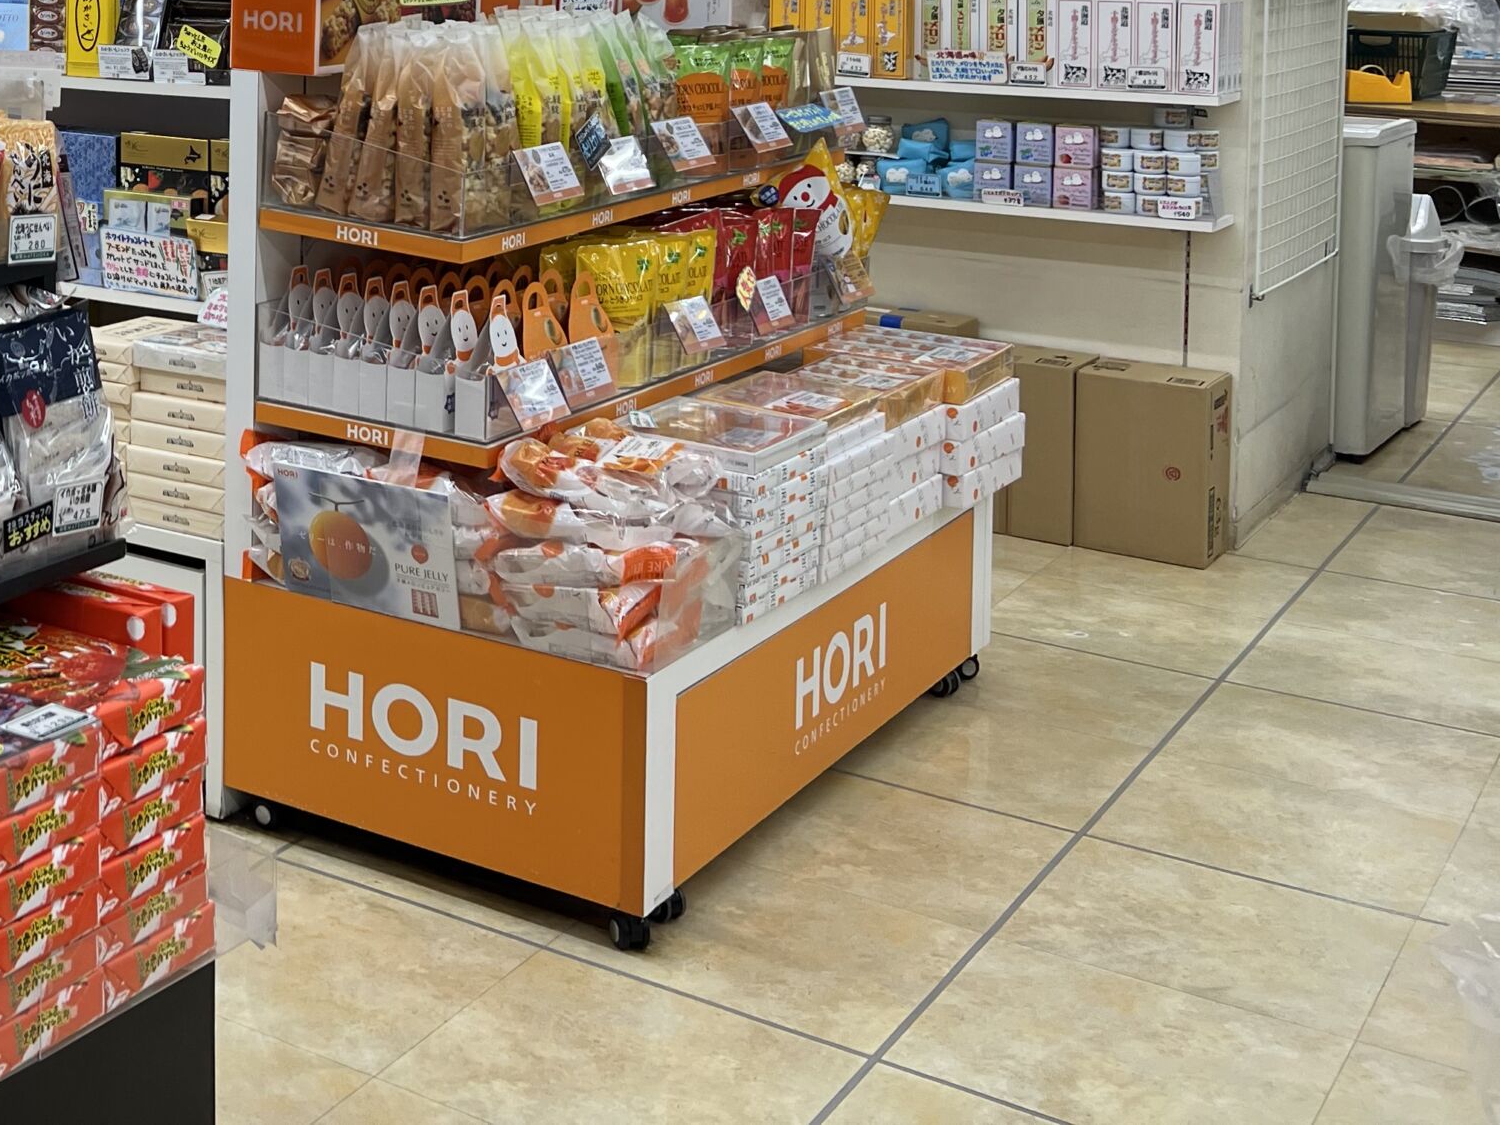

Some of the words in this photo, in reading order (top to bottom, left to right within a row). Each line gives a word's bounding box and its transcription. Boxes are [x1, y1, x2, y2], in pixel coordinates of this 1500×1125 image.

[242, 10, 303, 32] HORI
[672, 189, 691, 205] HORI
[592, 210, 614, 226] HORI
[27, 238, 46, 250] 280
[336, 225, 379, 246] HORI
[502, 231, 527, 252] HORI
[827, 321, 843, 336] HORI
[764, 344, 782, 360] HORI
[695, 370, 714, 387] HORI
[616, 397, 638, 417] HORI
[347, 424, 389, 446] HORI
[275, 467, 299, 479] HORI
[7, 519, 51, 548] おすすめ
[394, 562, 418, 578] PURE
[419, 566, 450, 583] JELLY
[794, 601, 888, 731] HORI
[310, 661, 539, 791] HORI
[794, 675, 888, 757] CONFECTIONERY
[309, 737, 538, 817] CONFECTIONERY
